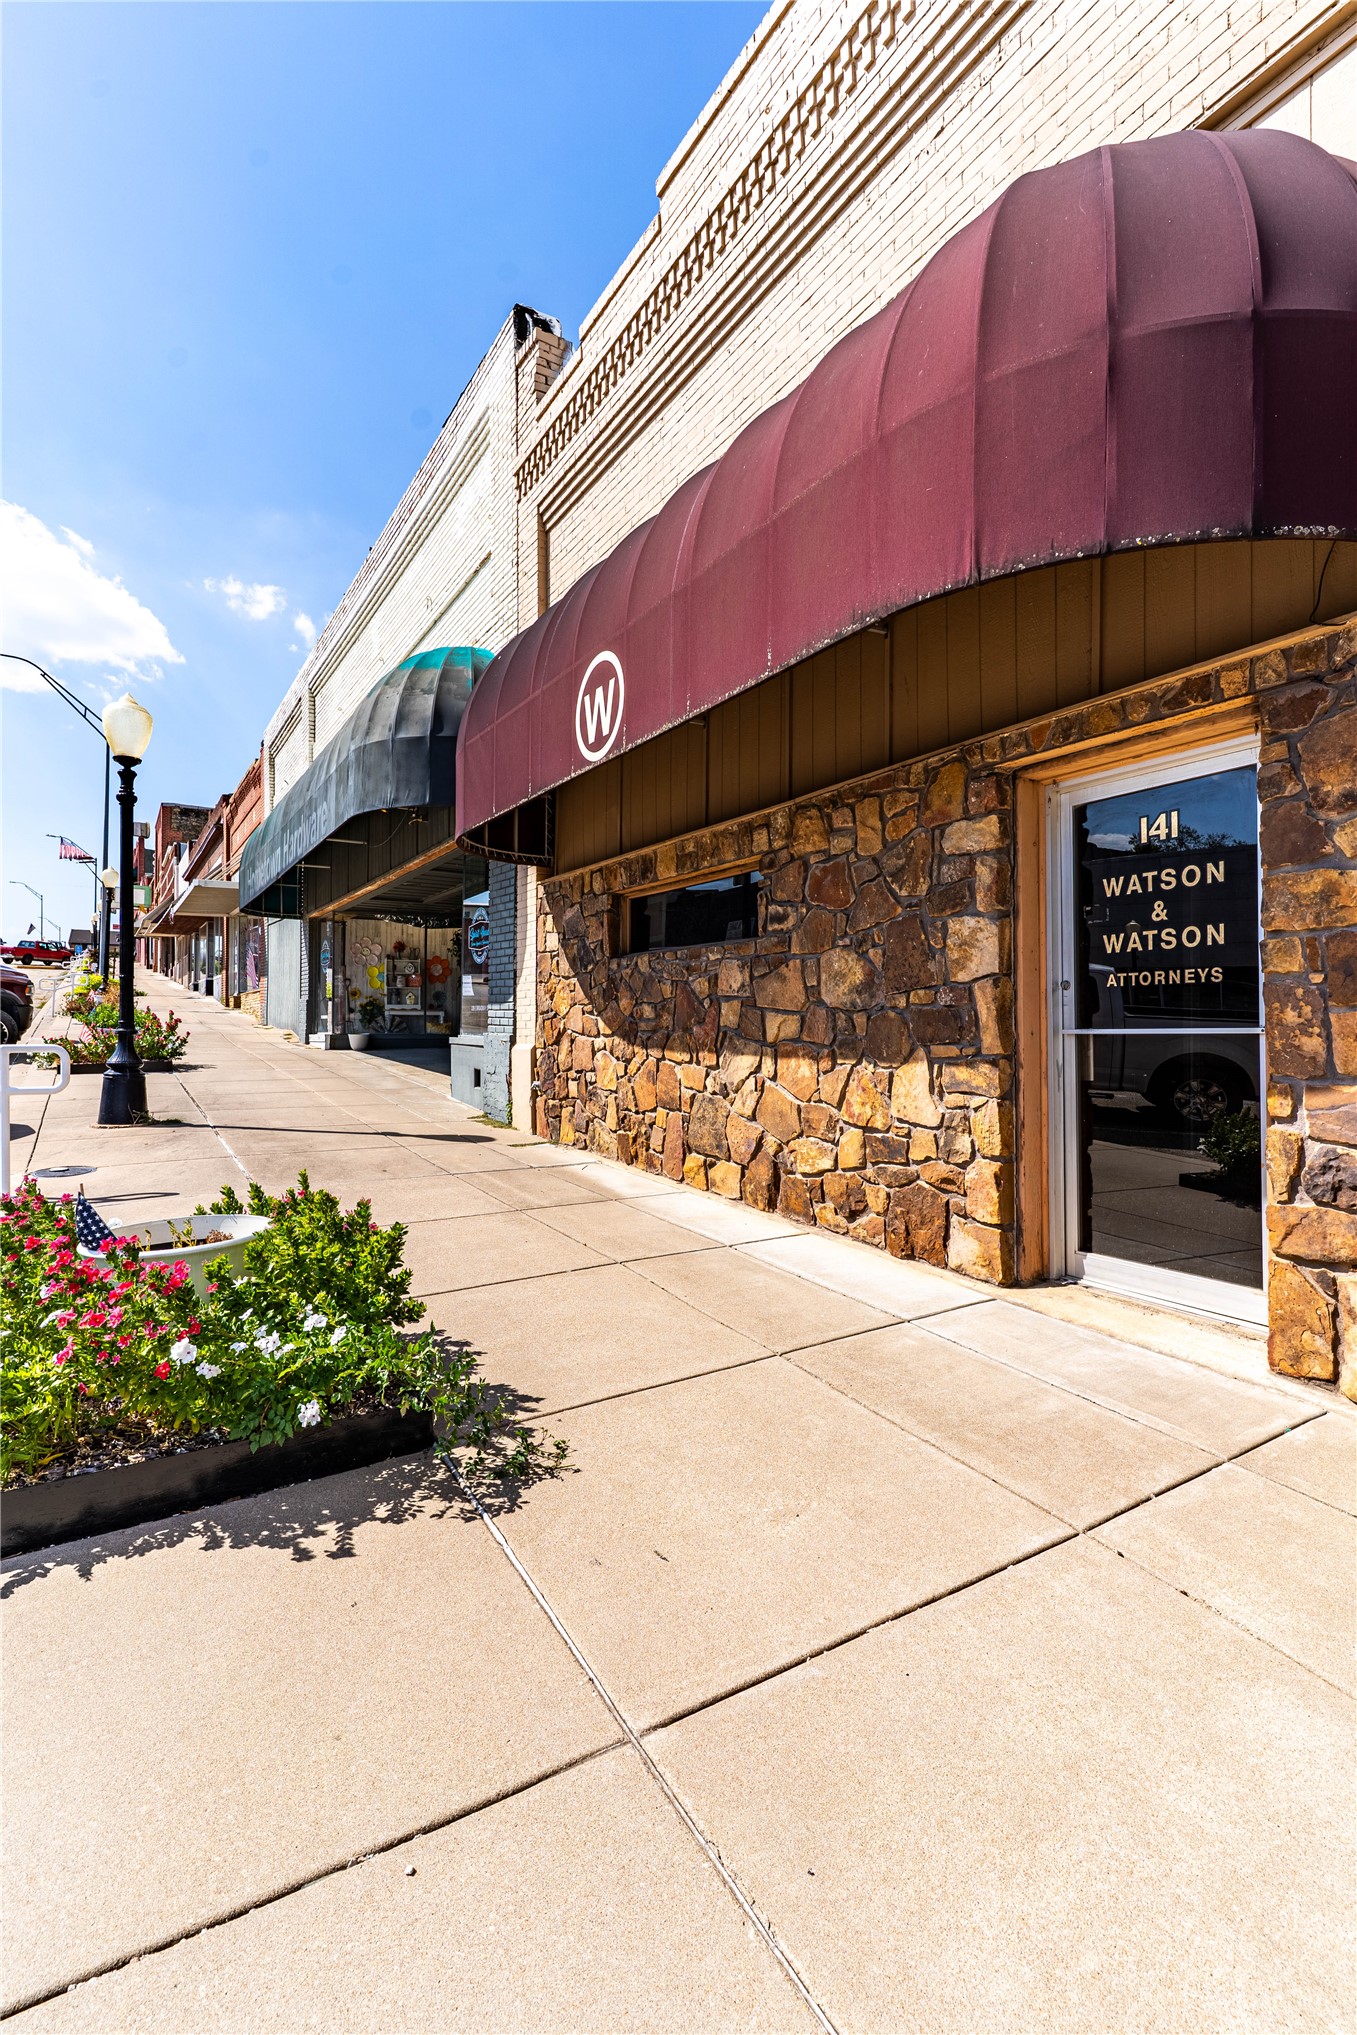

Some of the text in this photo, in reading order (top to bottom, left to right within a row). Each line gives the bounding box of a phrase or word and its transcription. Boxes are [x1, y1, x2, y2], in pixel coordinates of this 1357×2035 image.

[584, 677, 615, 745] W
[283, 801, 328, 869] Hardware
[1140, 810, 1179, 844] 141
[1102, 861, 1225, 898] WATSON
[1151, 900, 1168, 922] &
[1103, 923, 1225, 954] WATSON
[1106, 966, 1224, 988] ATTORNEYS
